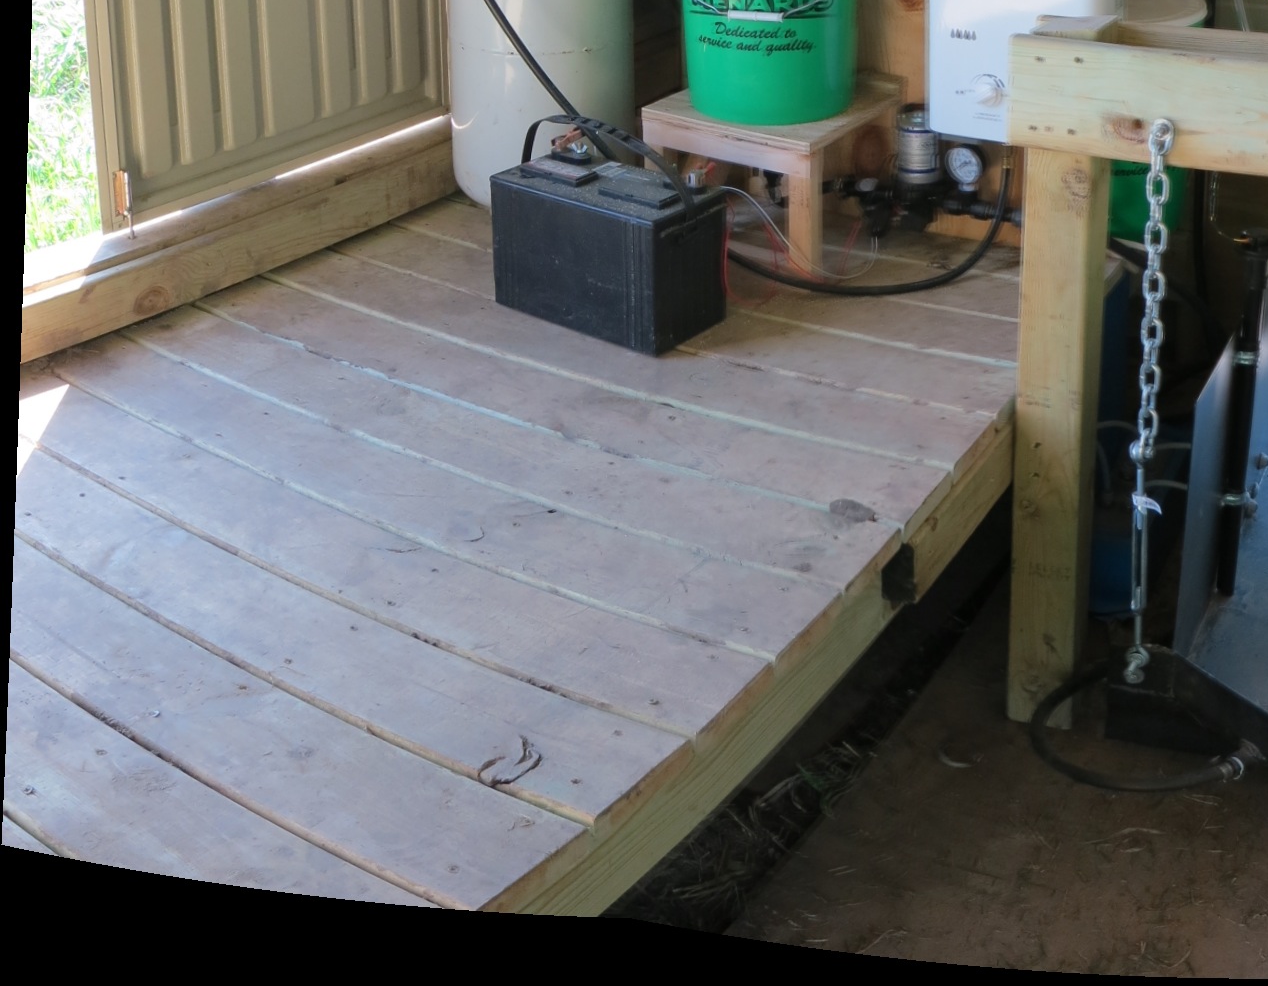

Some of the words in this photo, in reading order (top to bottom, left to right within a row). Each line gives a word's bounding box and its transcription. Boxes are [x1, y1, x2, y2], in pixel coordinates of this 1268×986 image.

[715, 21, 779, 39] Dedicated
[784, 27, 798, 39] to
[698, 34, 732, 49] service
[736, 40, 762, 52] and
